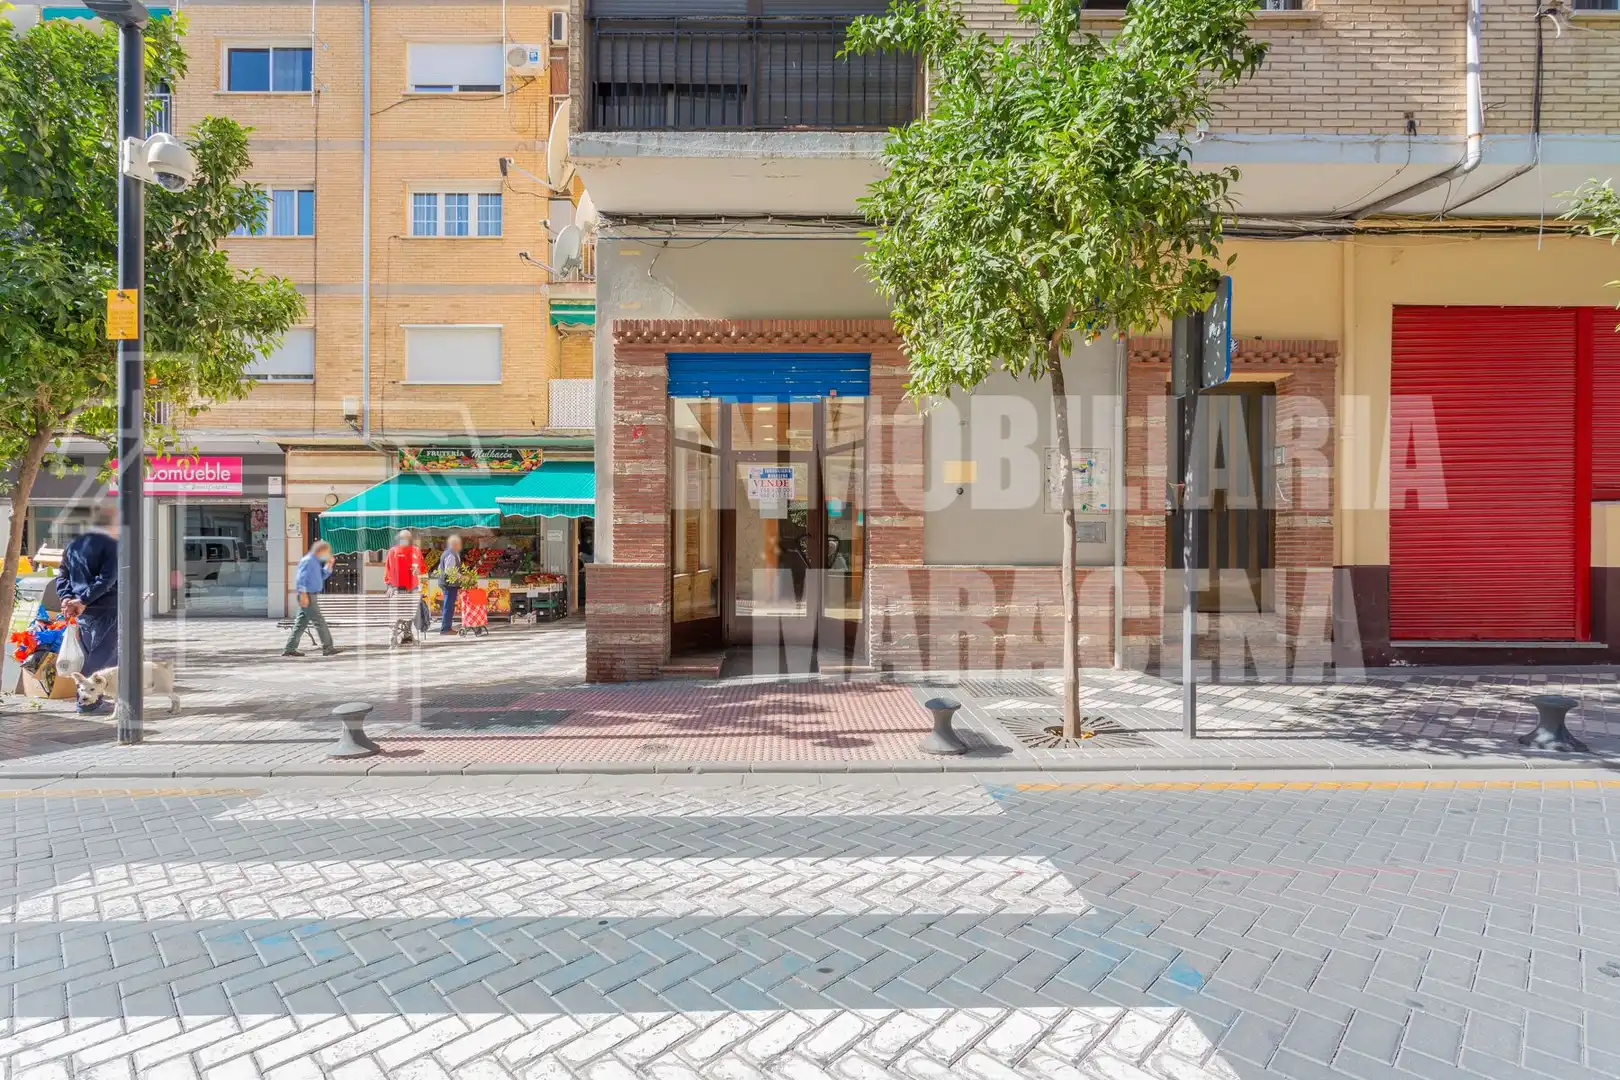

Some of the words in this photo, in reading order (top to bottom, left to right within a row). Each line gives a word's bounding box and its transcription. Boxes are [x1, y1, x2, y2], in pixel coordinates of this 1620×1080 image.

[426, 449, 465, 457] FRUTERÍA
[470, 448, 513, 459] Mulhacén
[753, 480, 788, 488] VENDE
